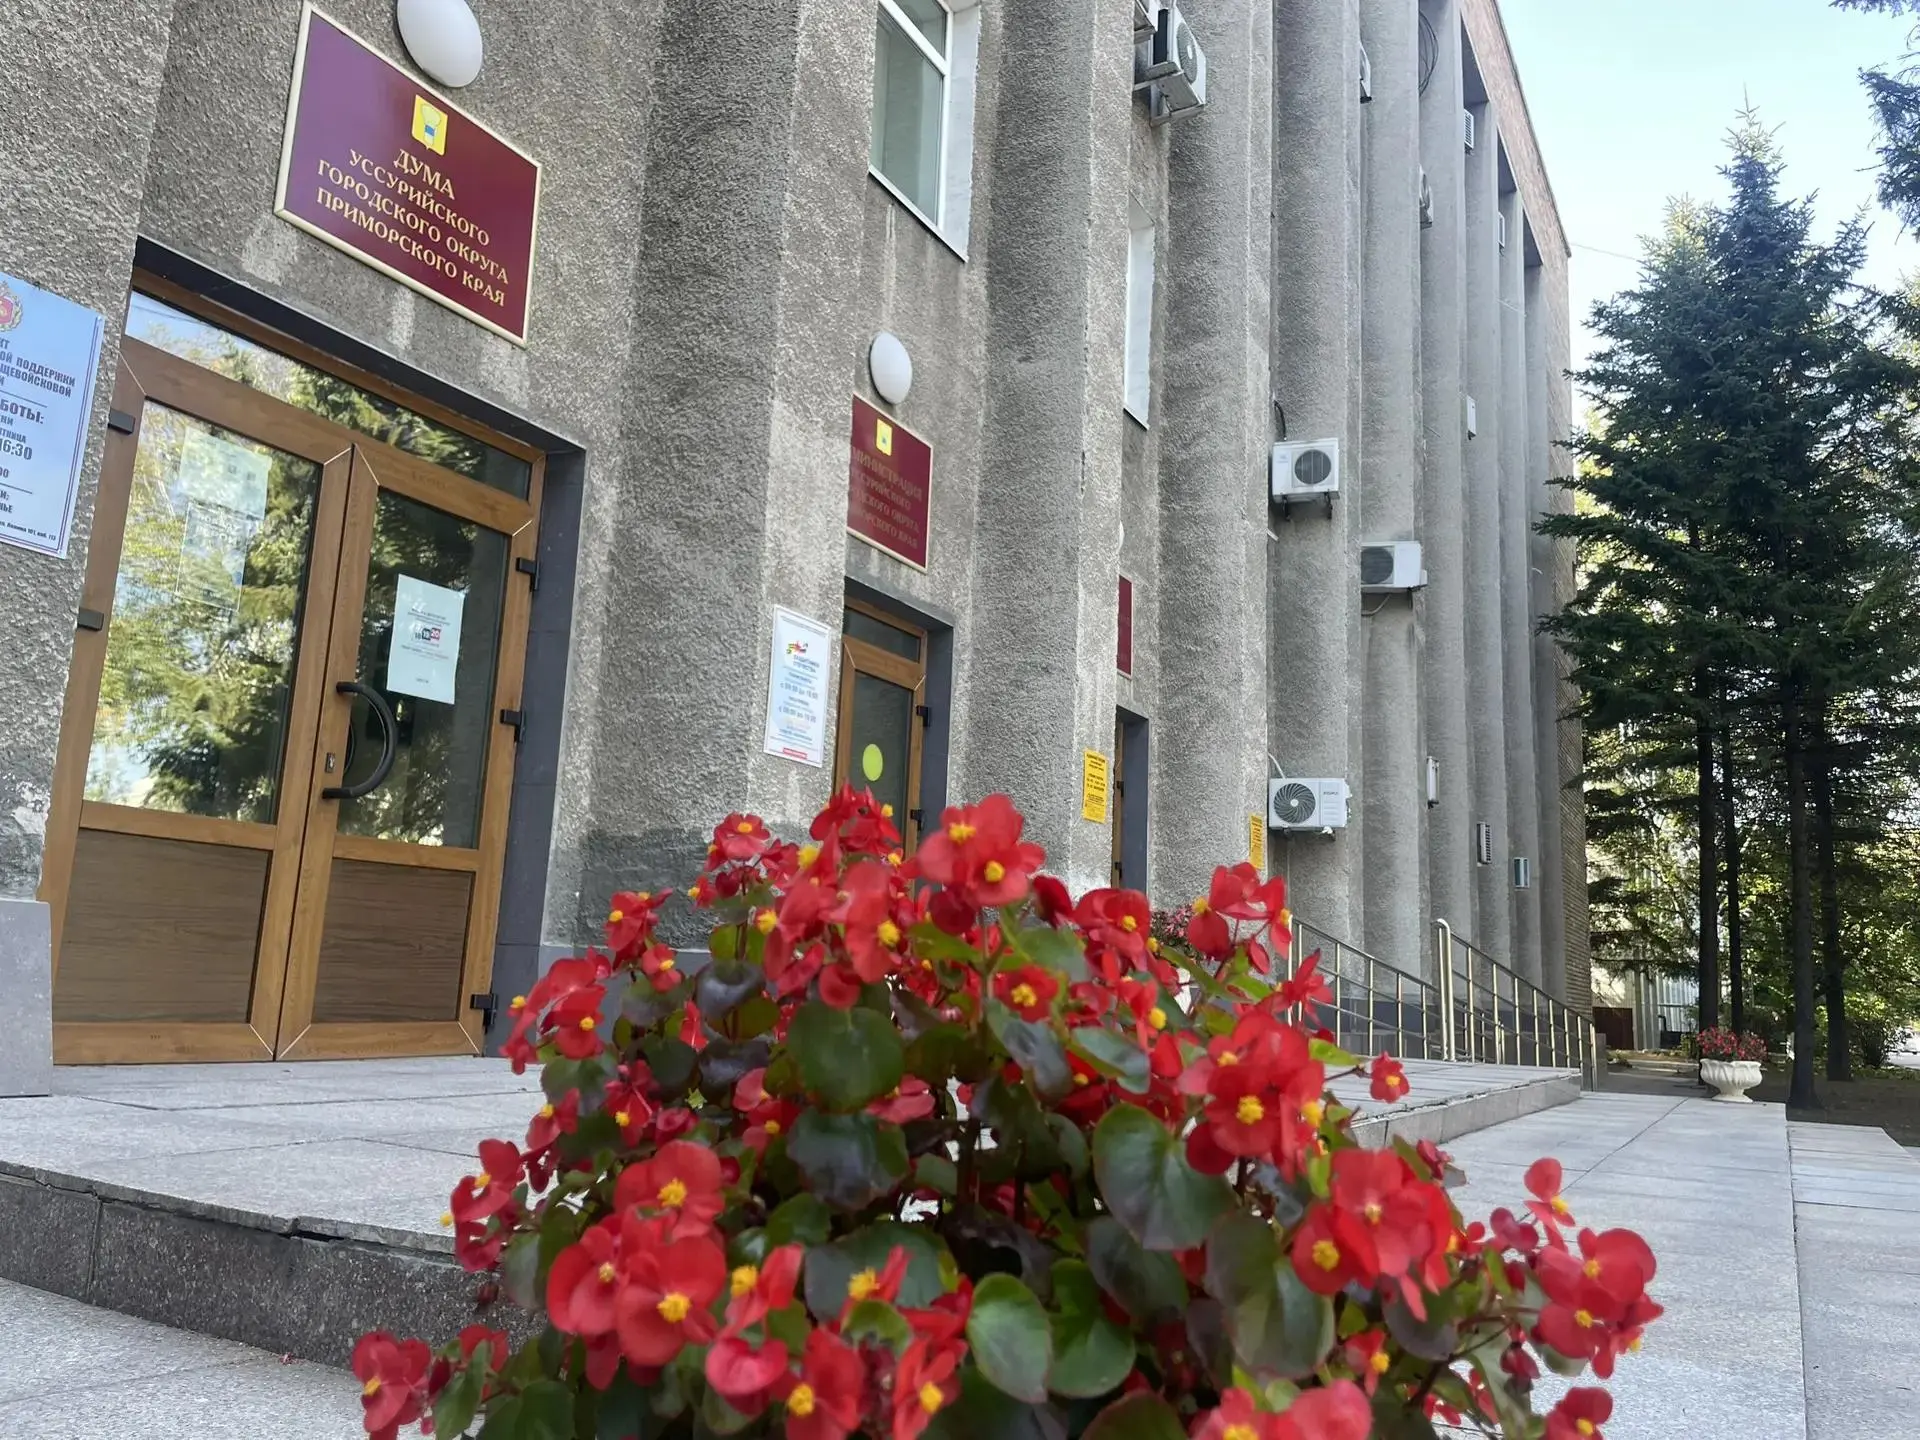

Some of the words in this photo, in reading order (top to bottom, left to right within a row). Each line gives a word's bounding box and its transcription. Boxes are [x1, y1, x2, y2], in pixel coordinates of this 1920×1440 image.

[349, 149, 489, 246] УССУРИЙСКОГО
[393, 149, 455, 200] ДУМА
[316, 187, 457, 278] ПРИМОРСКОГО
[462, 271, 505, 307] КРАЯ
[317, 159, 441, 242] ГОРОДСКОГО
[446, 237, 508, 284] ОКРУГА
[16, 356, 76, 387] ПОДДЕРЖКИ
[0, 398, 44, 424] БОТЫ:
